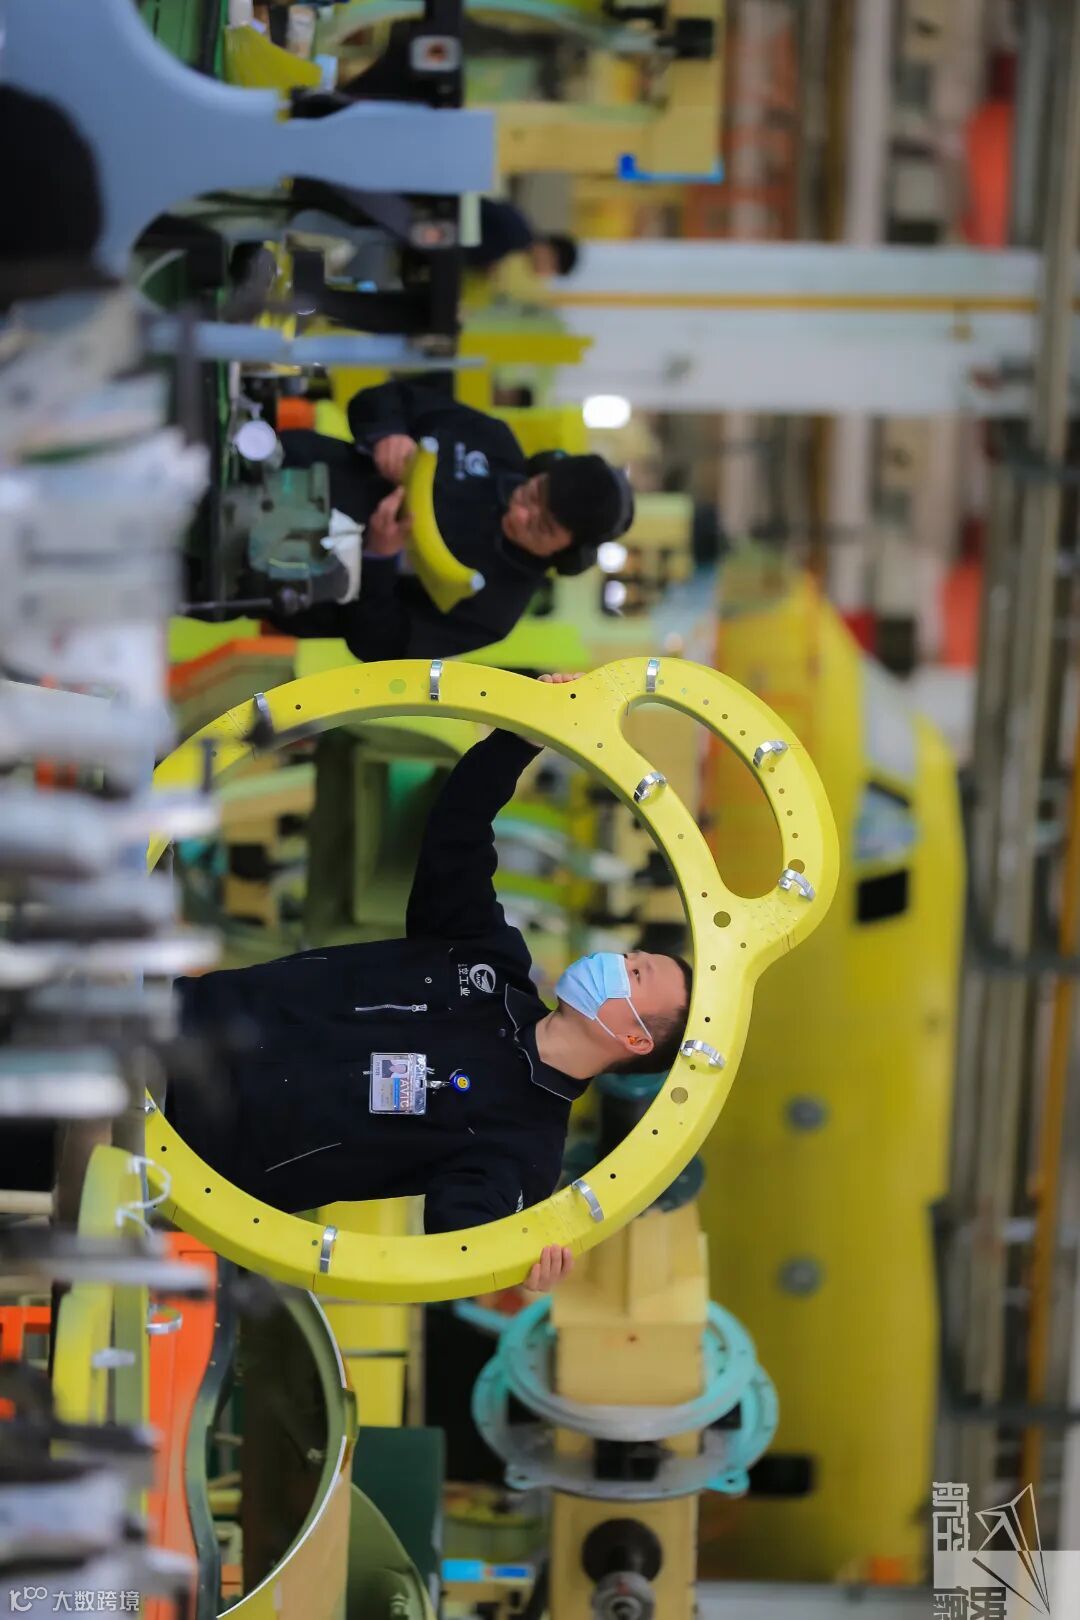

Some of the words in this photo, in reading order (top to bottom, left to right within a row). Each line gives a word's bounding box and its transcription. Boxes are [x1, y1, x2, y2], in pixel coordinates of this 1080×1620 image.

[457, 963, 471, 997] 空工业
[400, 1079, 410, 1108] AVIC
